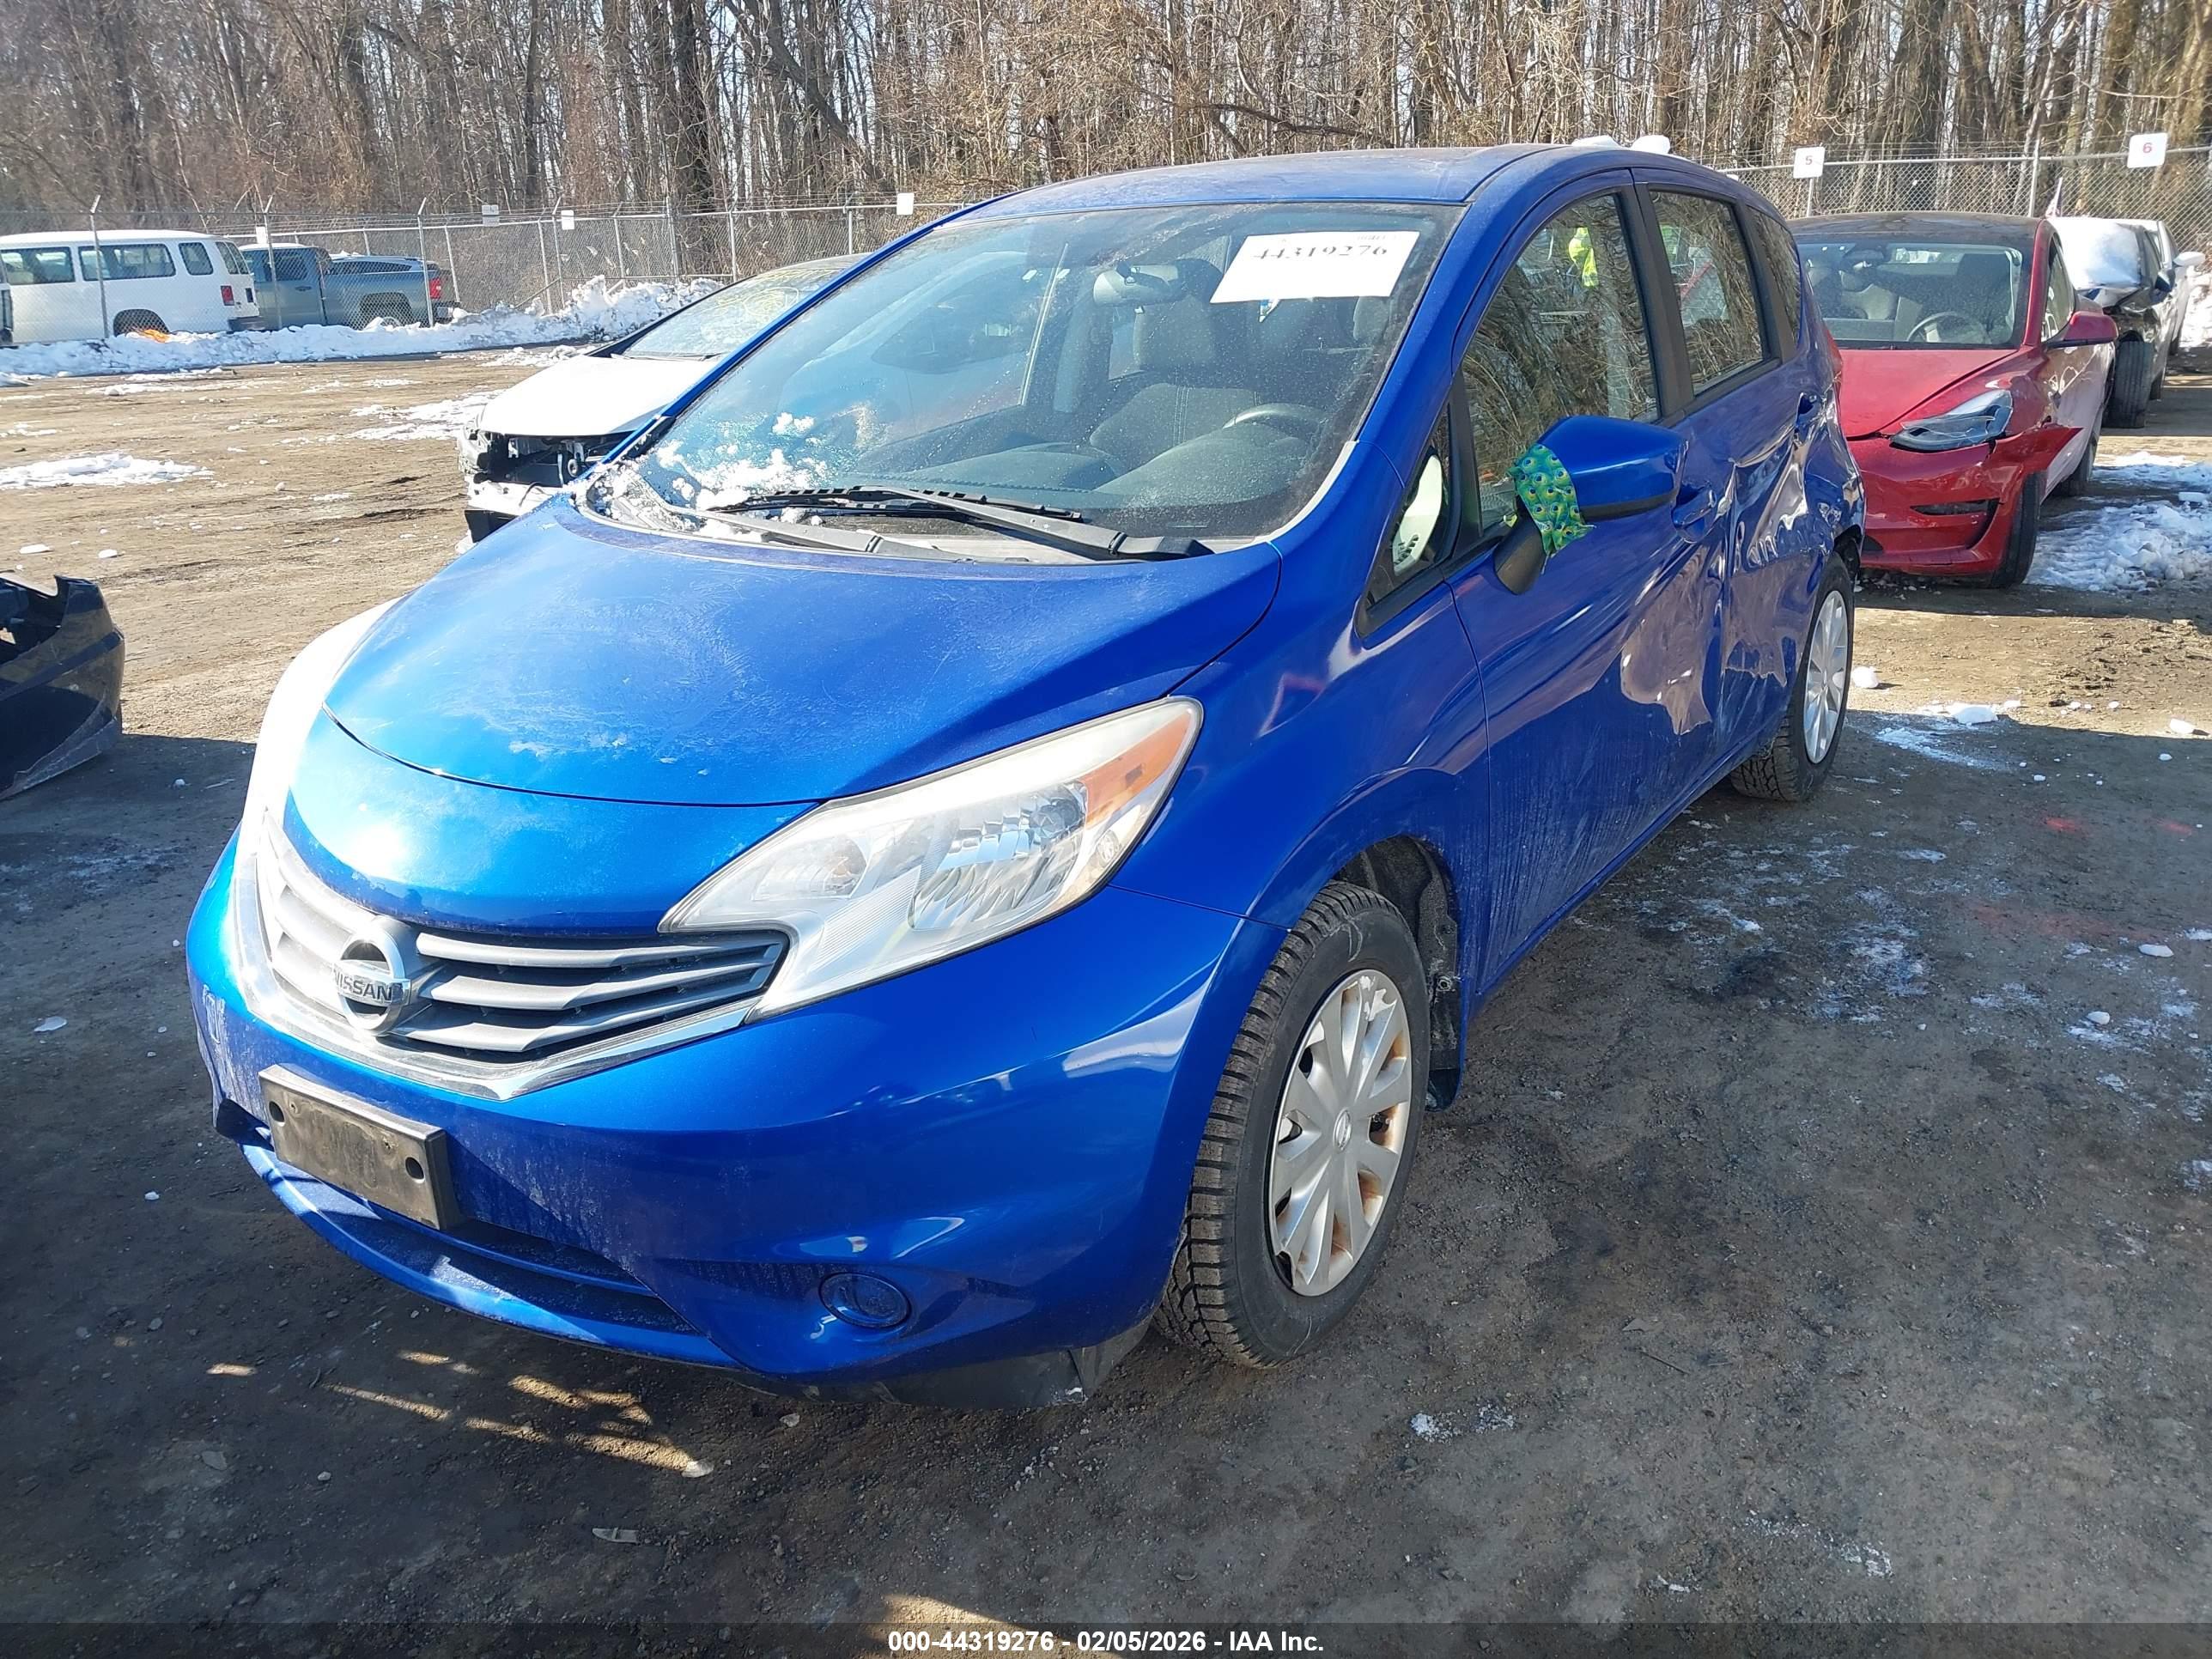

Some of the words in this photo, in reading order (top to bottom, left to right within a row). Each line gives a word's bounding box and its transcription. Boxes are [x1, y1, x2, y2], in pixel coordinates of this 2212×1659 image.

[2142, 142, 2153, 154] 6
[1805, 155, 1813, 166] 5
[1253, 244, 1389, 259] 44319276
[332, 968, 392, 1001] NISSAN
